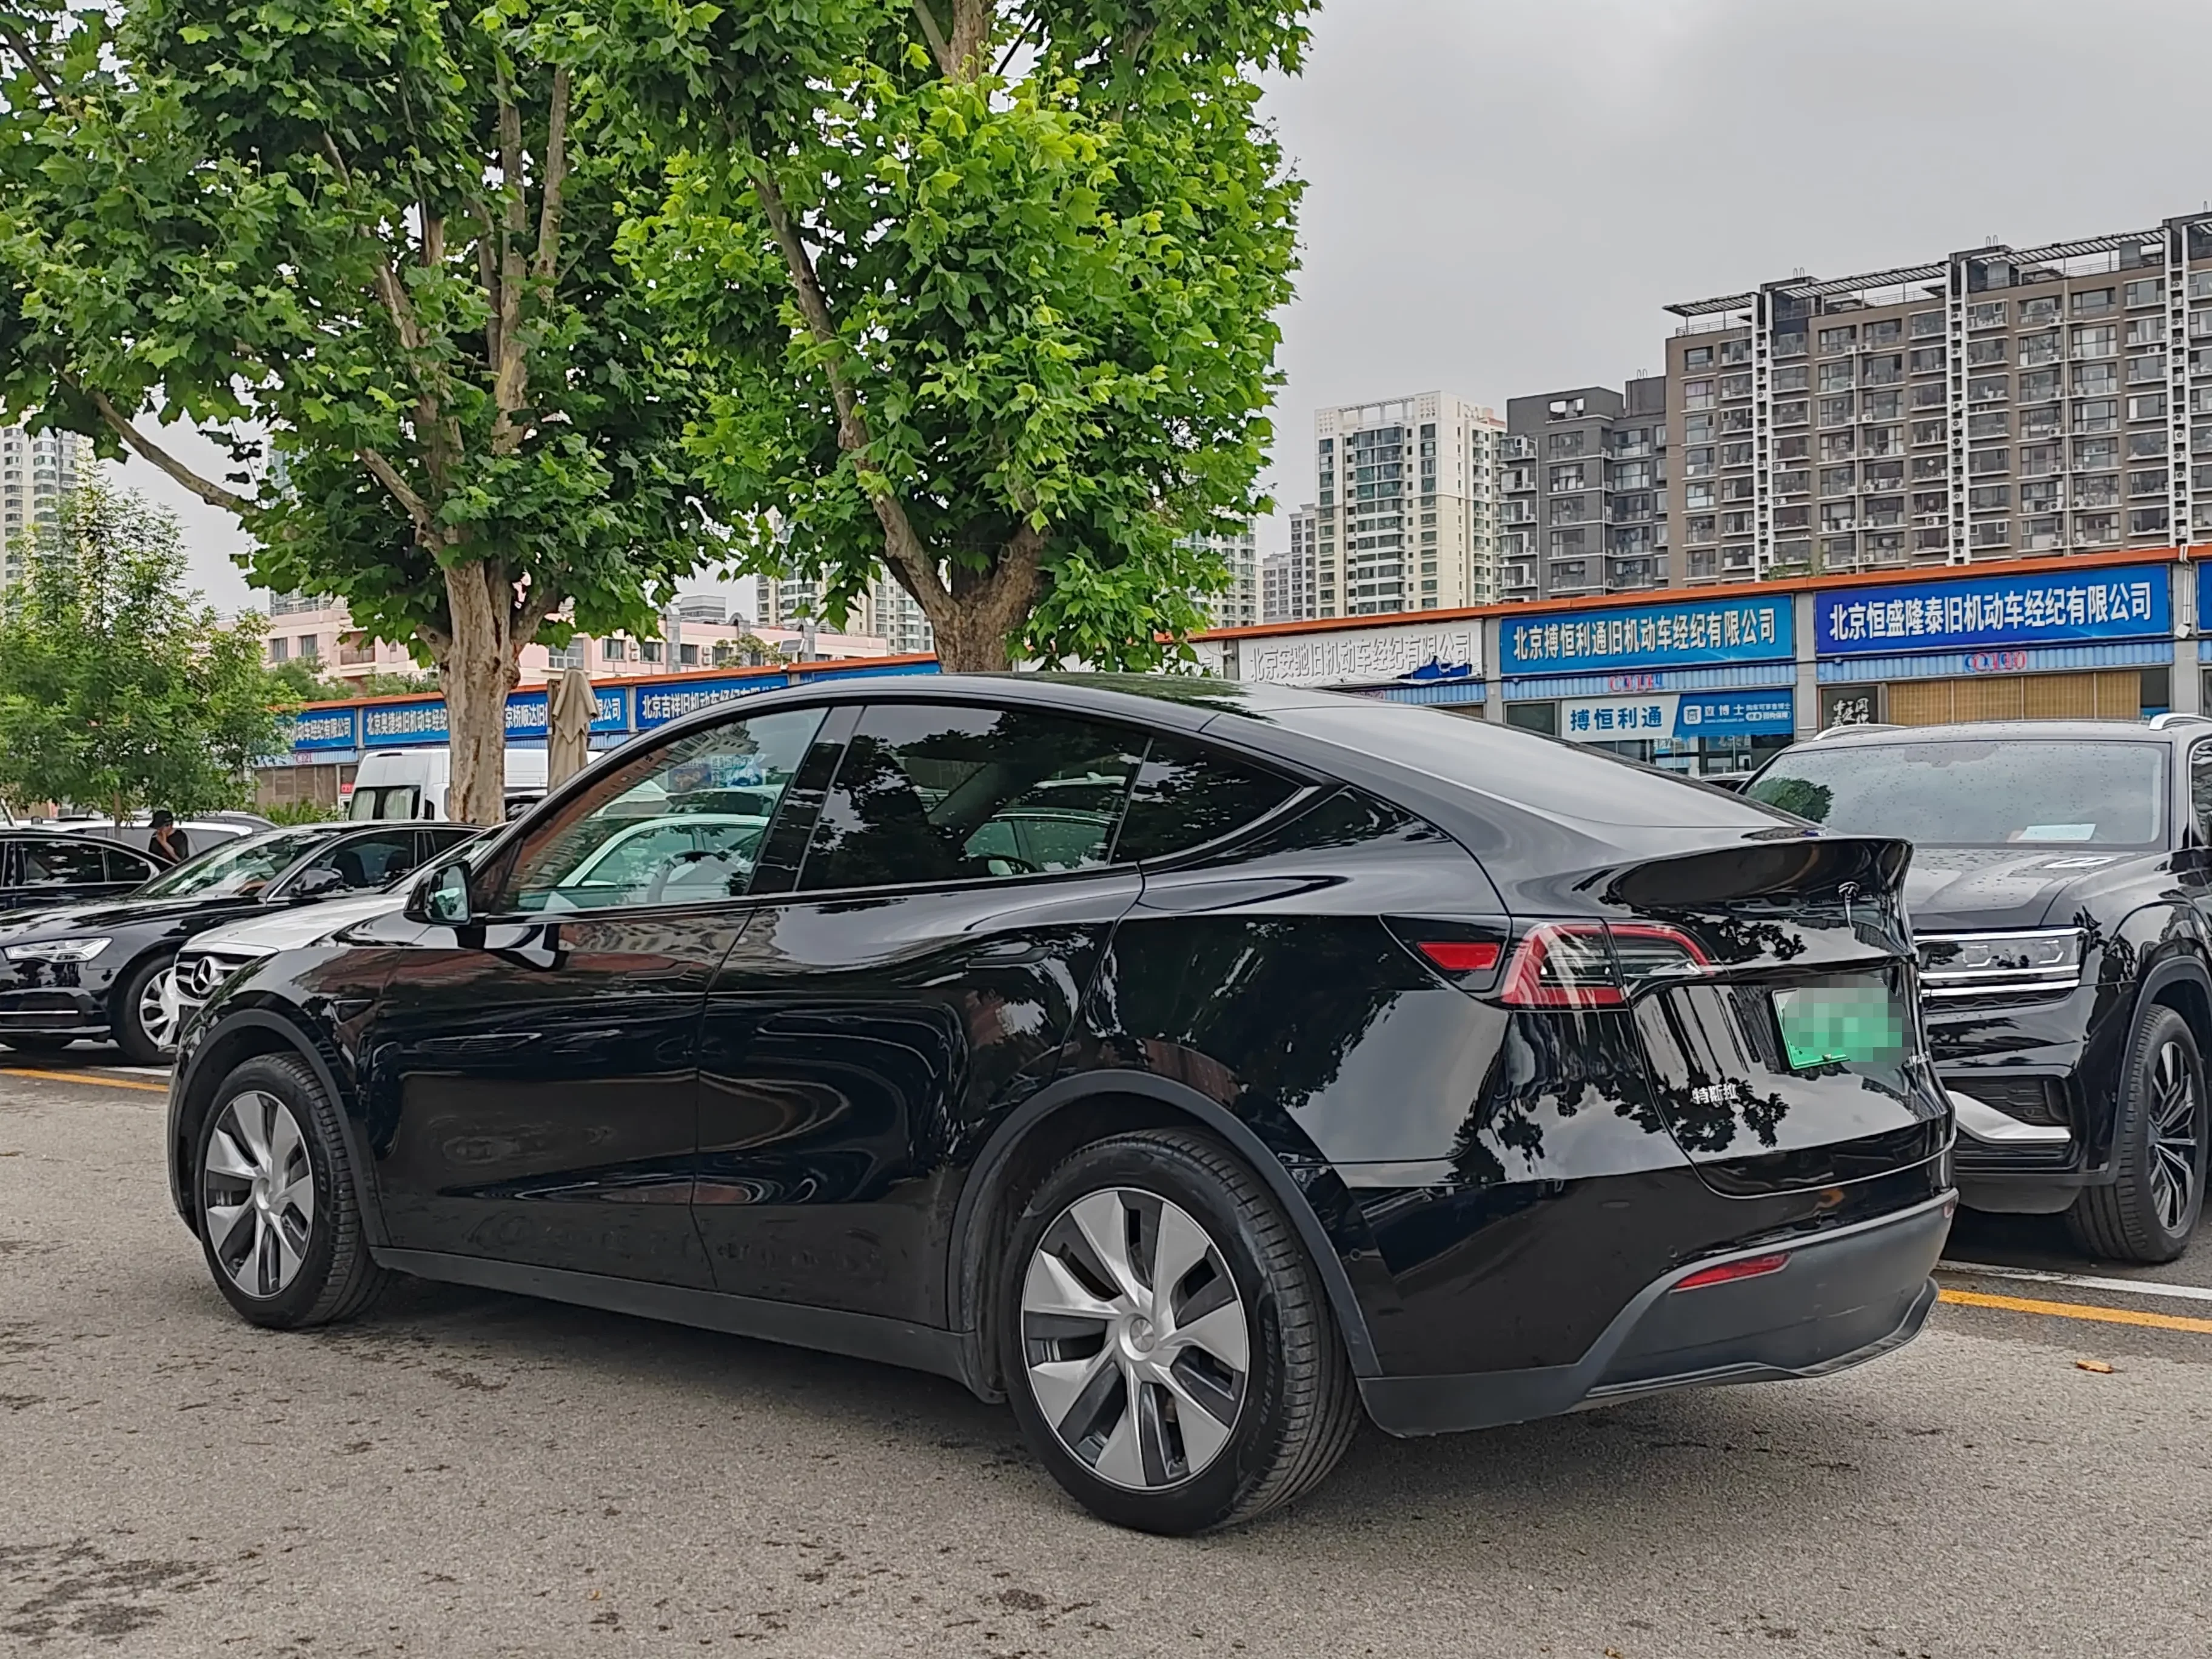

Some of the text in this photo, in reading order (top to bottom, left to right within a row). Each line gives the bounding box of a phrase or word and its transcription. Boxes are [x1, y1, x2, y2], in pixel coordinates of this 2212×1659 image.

[1829, 581, 2152, 641] 北京恒盛隆泰旧机动车经纪有限公司
[1513, 607, 1775, 661] 北京搏恒利通旧机动车经纪有限公司
[1570, 706, 1663, 731] 搏恒利通
[1690, 1083, 1741, 1105] 特斯拉
